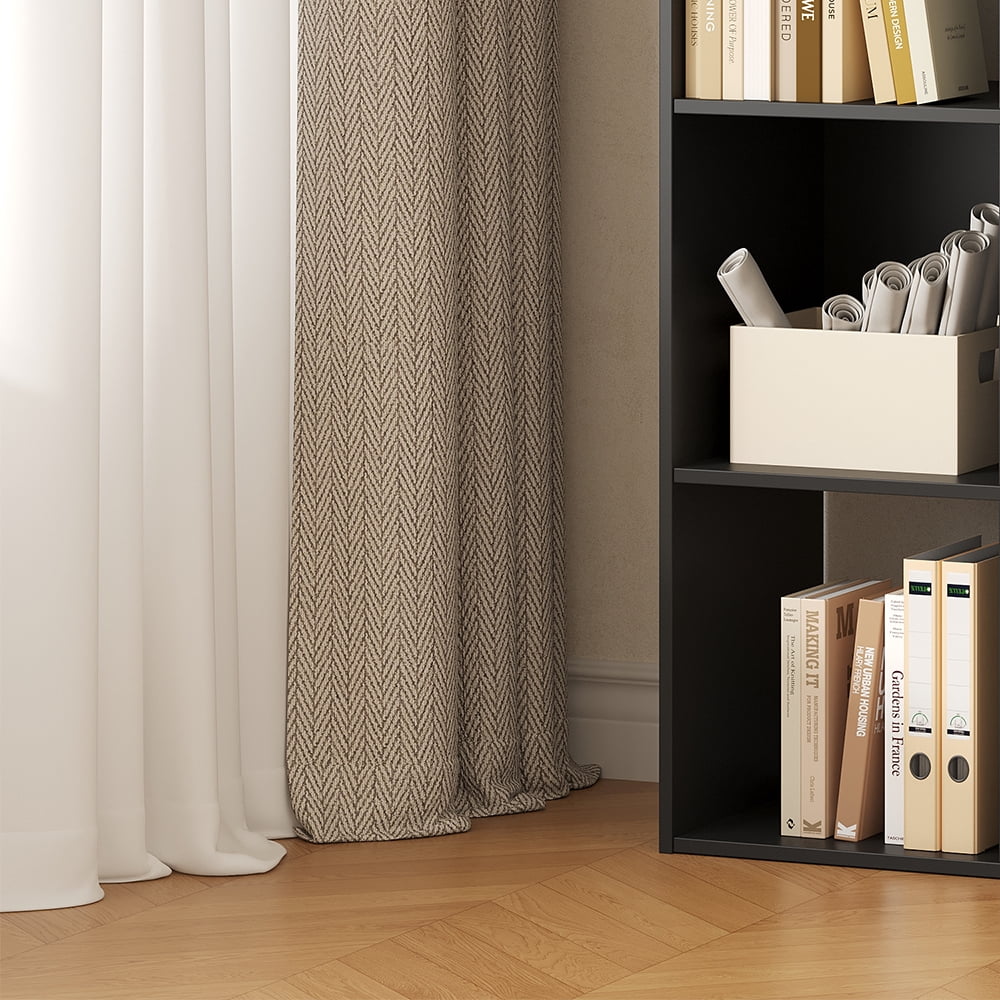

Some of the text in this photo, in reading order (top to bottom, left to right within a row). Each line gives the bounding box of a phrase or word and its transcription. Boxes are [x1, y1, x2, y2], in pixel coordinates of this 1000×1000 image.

[690, 12, 698, 47] HOUSES
[728, 24, 737, 36] OF
[891, 18, 903, 50] DESIGN
[805, 609, 820, 689] MAKING IT
[852, 645, 865, 695] HILARY FRENCH
[856, 647, 875, 737] NEW URBAN HOUSING
[891, 670, 904, 777] Gardens in France
